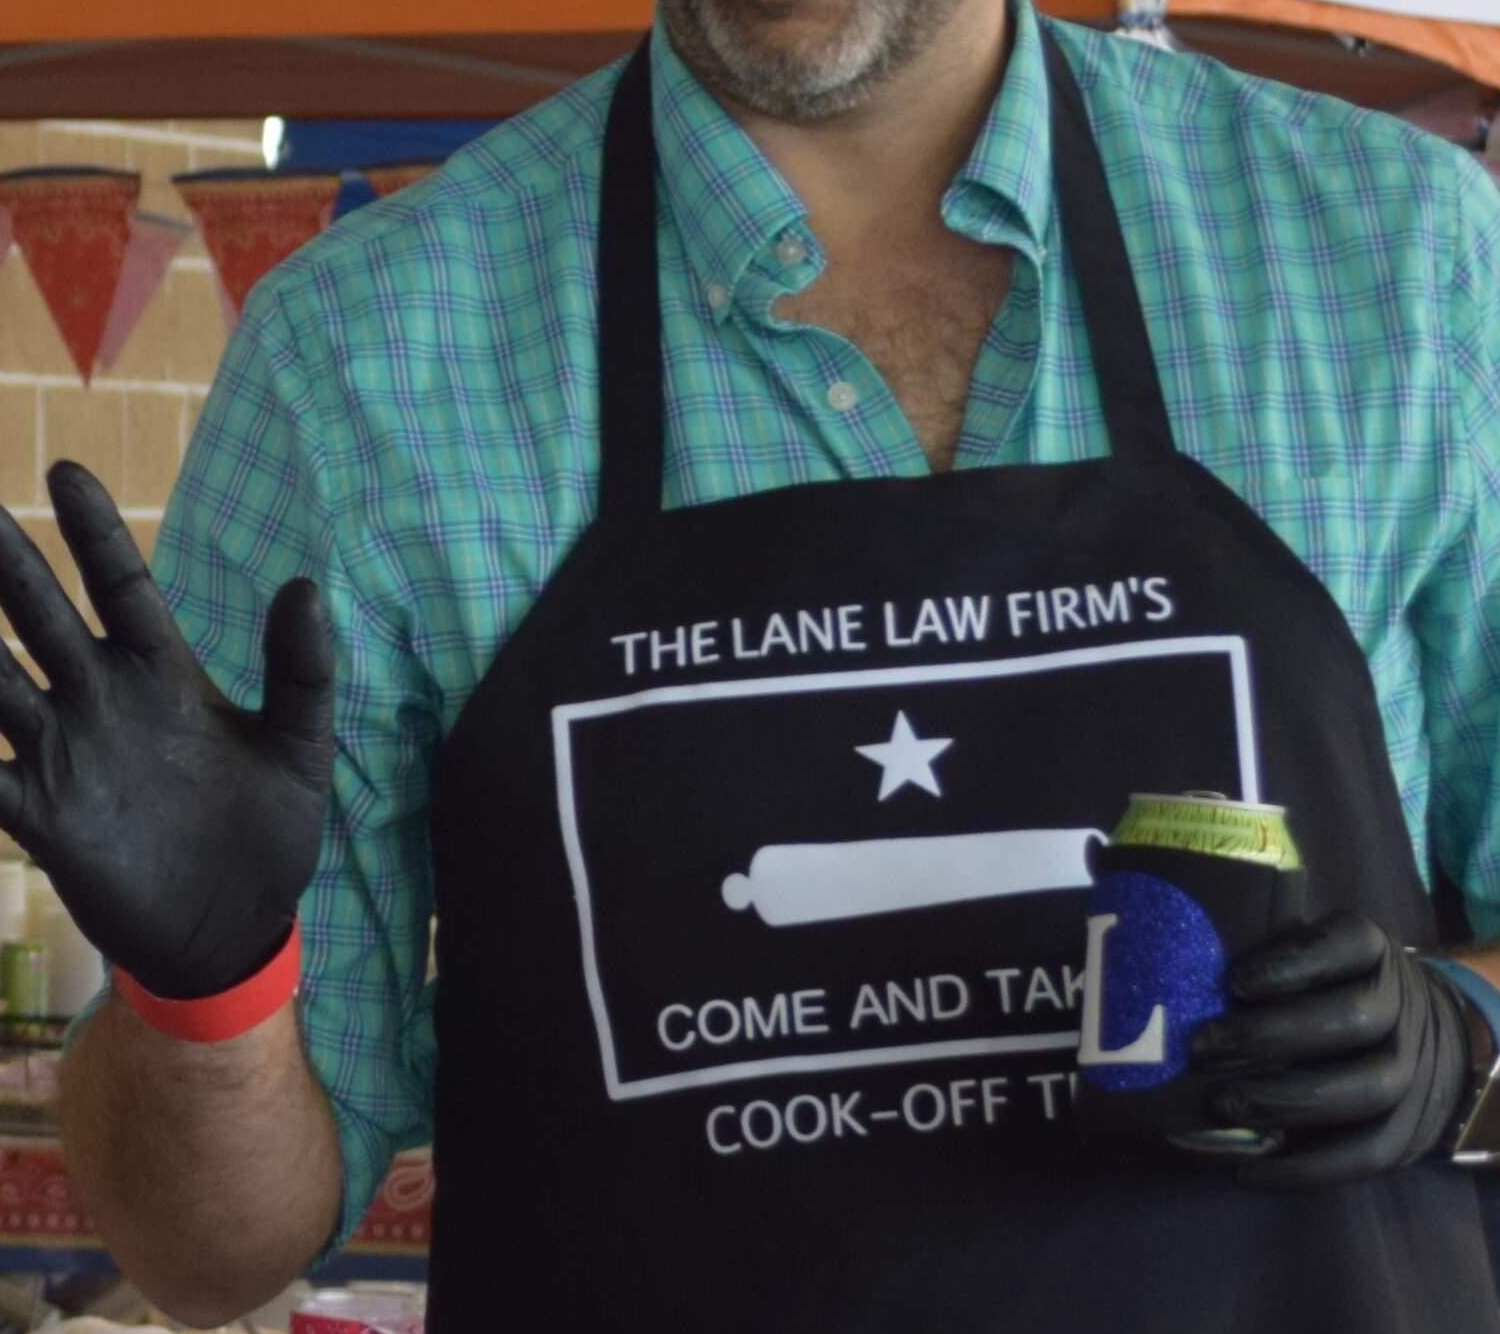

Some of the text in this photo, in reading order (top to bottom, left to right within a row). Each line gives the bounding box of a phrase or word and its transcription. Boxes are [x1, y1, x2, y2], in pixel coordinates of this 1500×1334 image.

[611, 576, 1175, 676] THE LANE LAW FIRM'S
[658, 965, 1086, 1052] COME AND TAK
[1078, 913, 1165, 1065] L
[706, 1077, 1008, 1156] COOK-OFF
